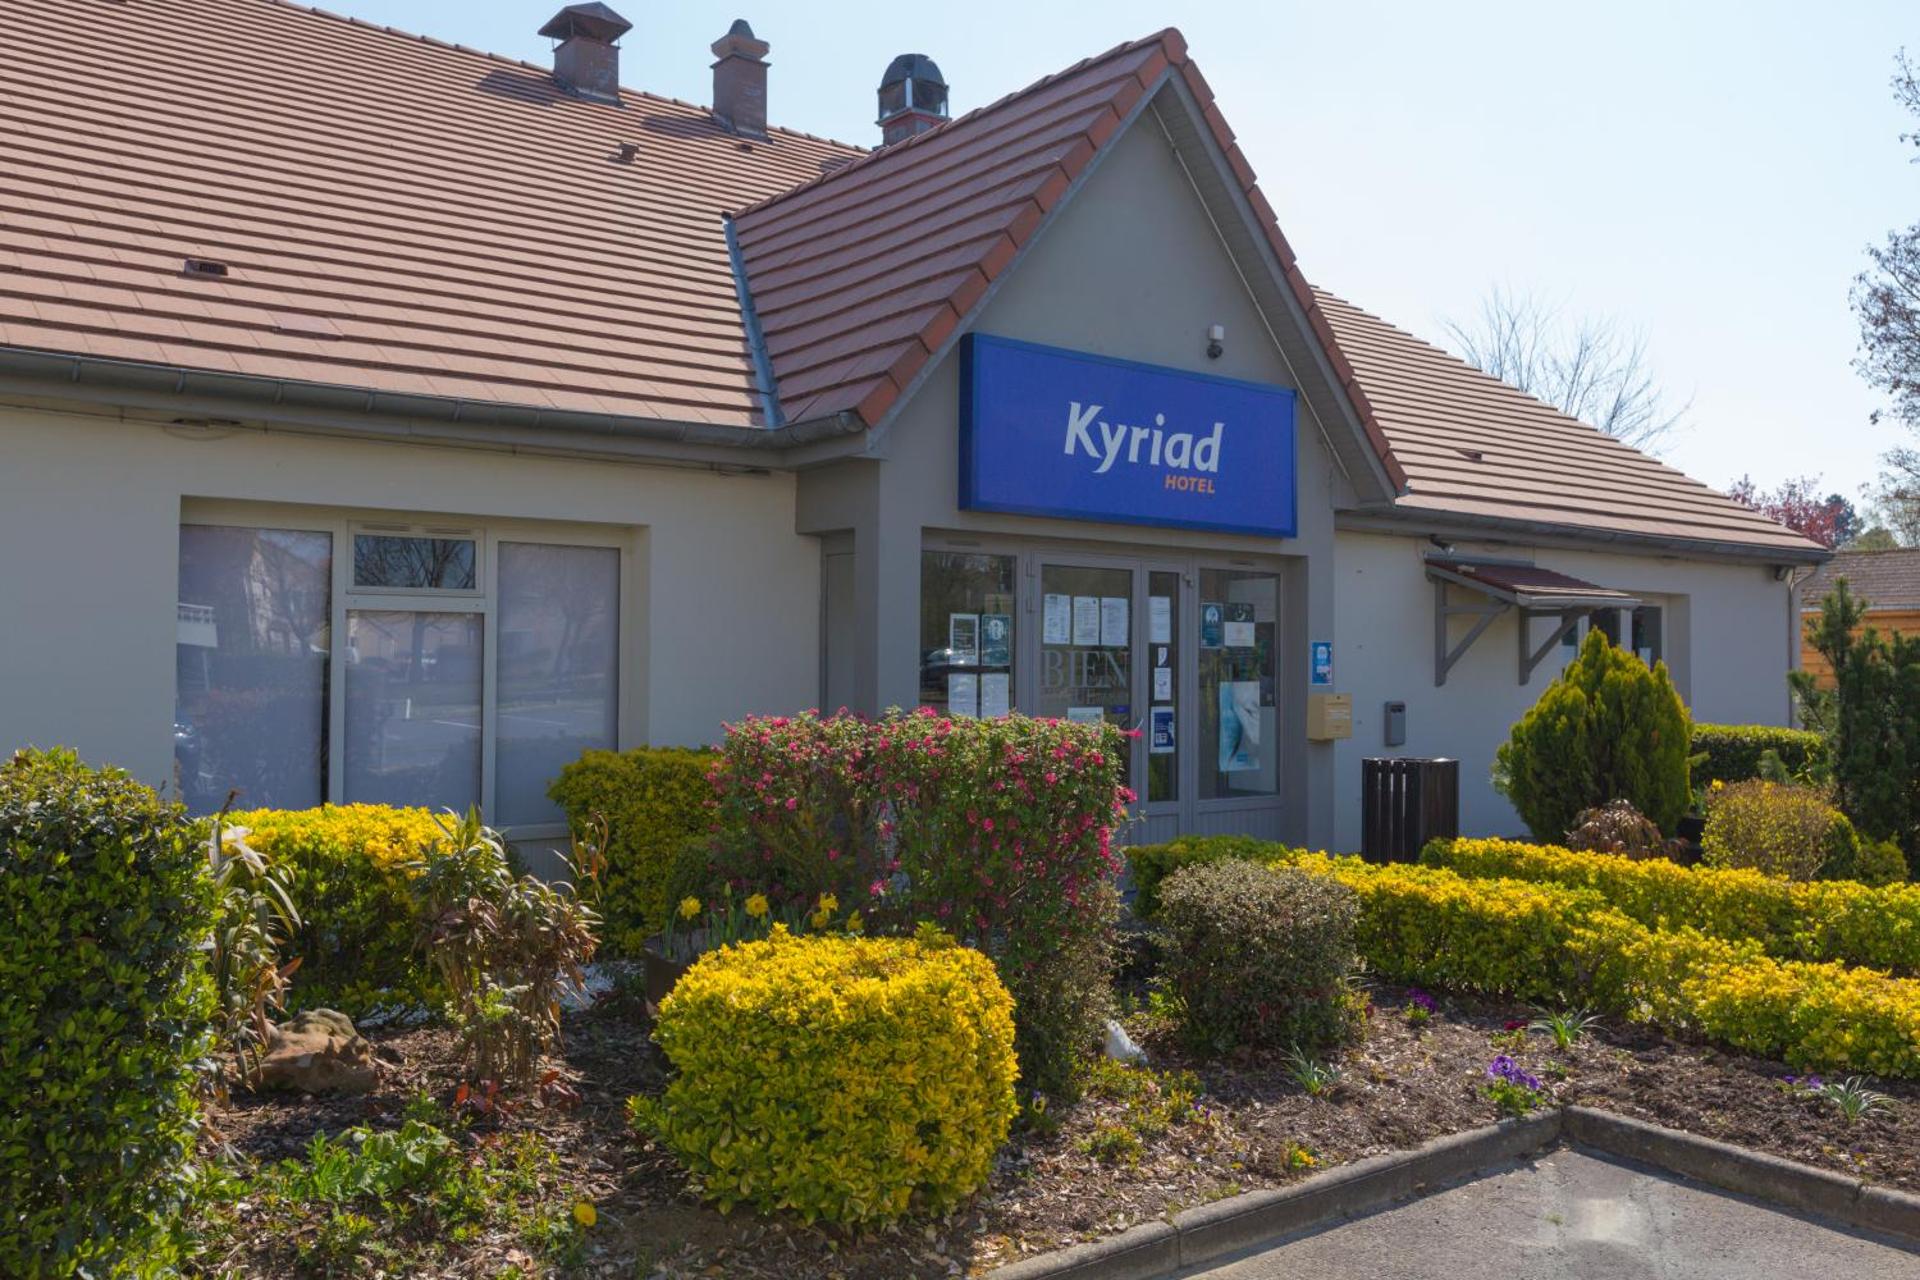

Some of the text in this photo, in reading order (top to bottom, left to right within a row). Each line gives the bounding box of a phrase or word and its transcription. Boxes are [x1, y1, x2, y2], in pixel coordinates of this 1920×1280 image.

[1064, 401, 1225, 473] Kyriad
[1164, 474, 1216, 494] HOTEL
[1040, 649, 1129, 688] BIEN
